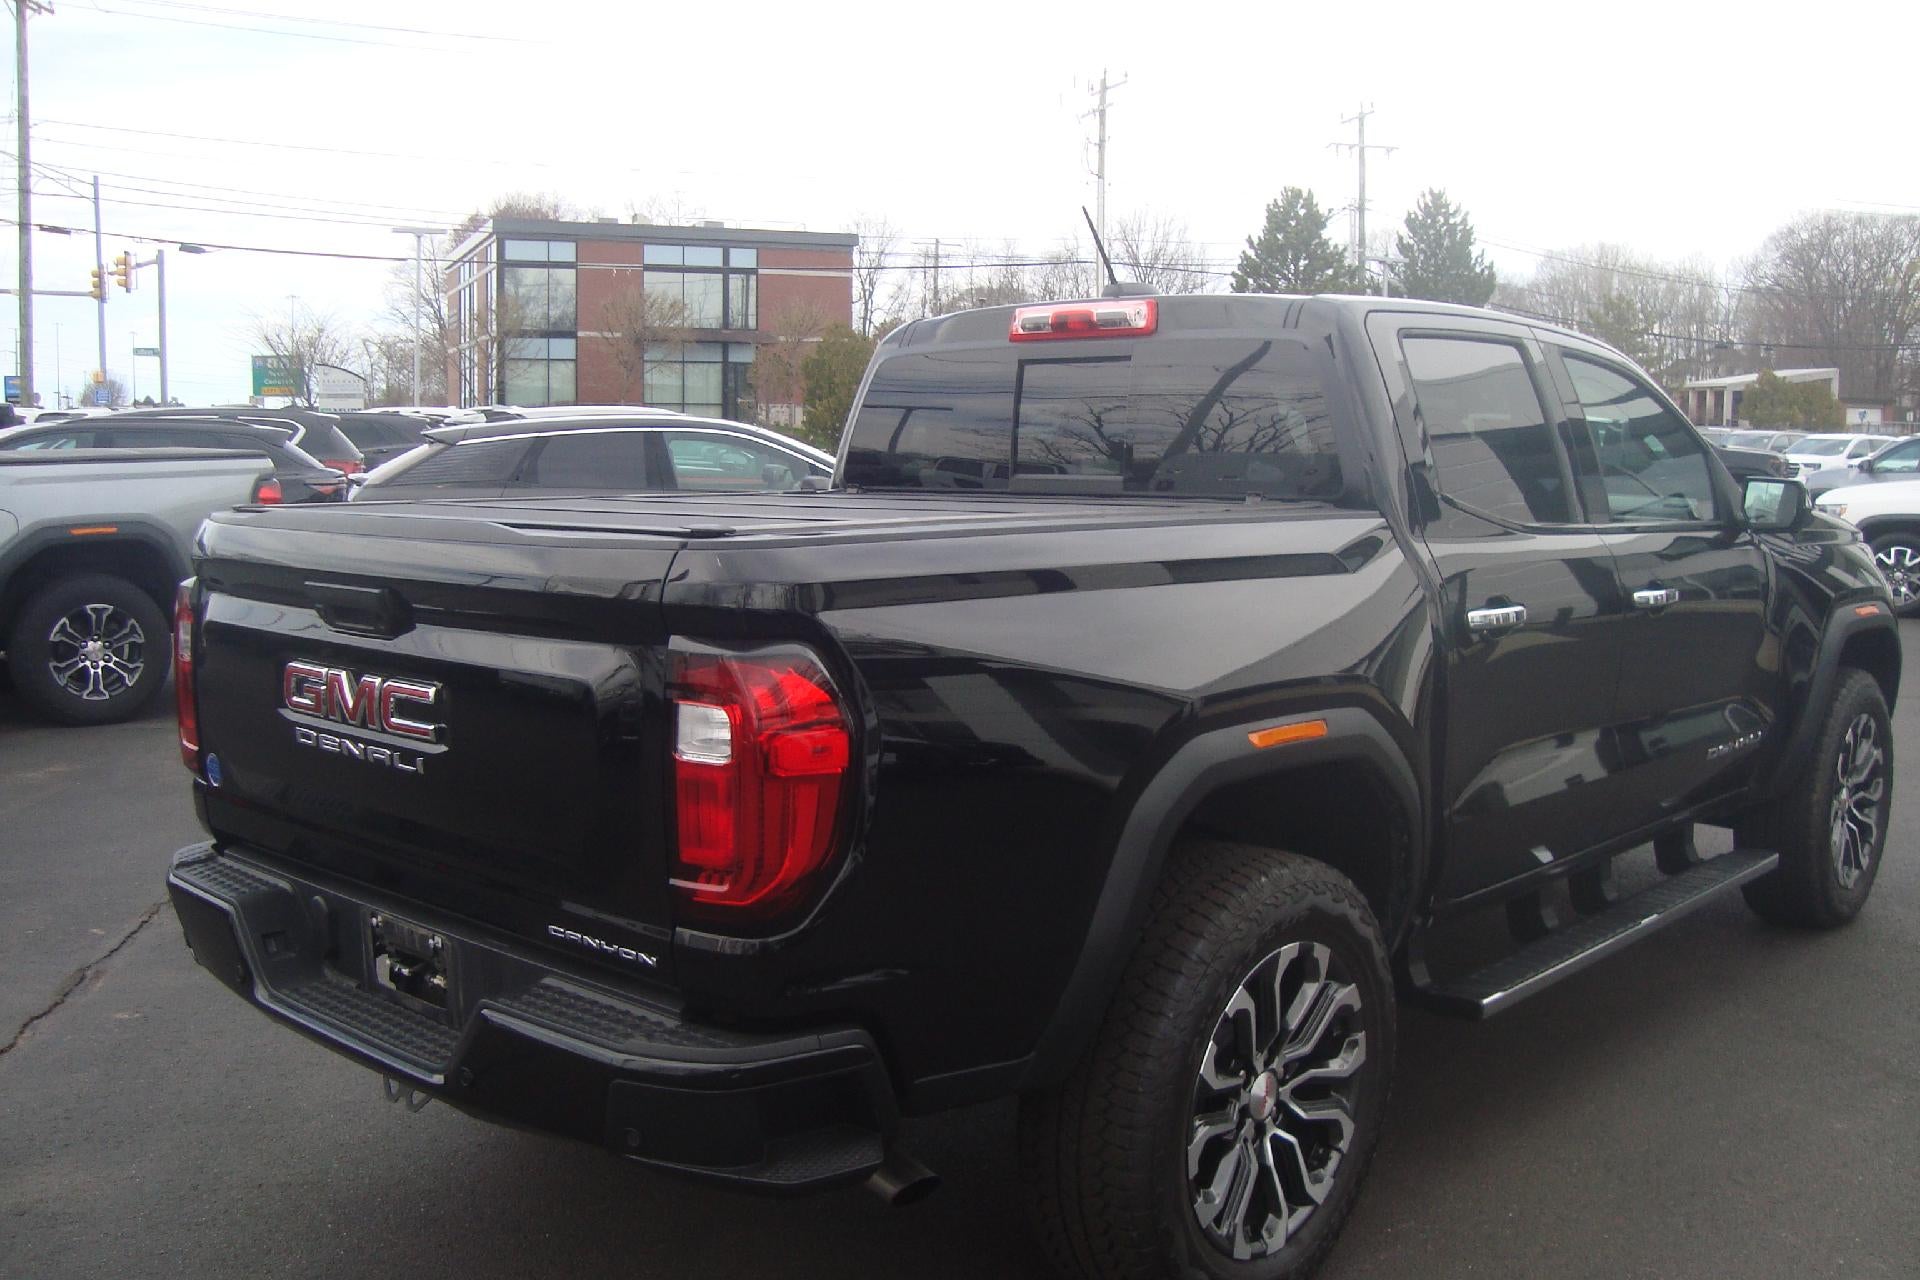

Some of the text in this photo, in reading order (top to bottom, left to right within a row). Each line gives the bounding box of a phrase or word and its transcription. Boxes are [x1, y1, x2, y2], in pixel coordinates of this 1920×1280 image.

[284, 661, 437, 743] GMC
[295, 727, 425, 775] DENALI
[548, 925, 657, 968] CANYON
